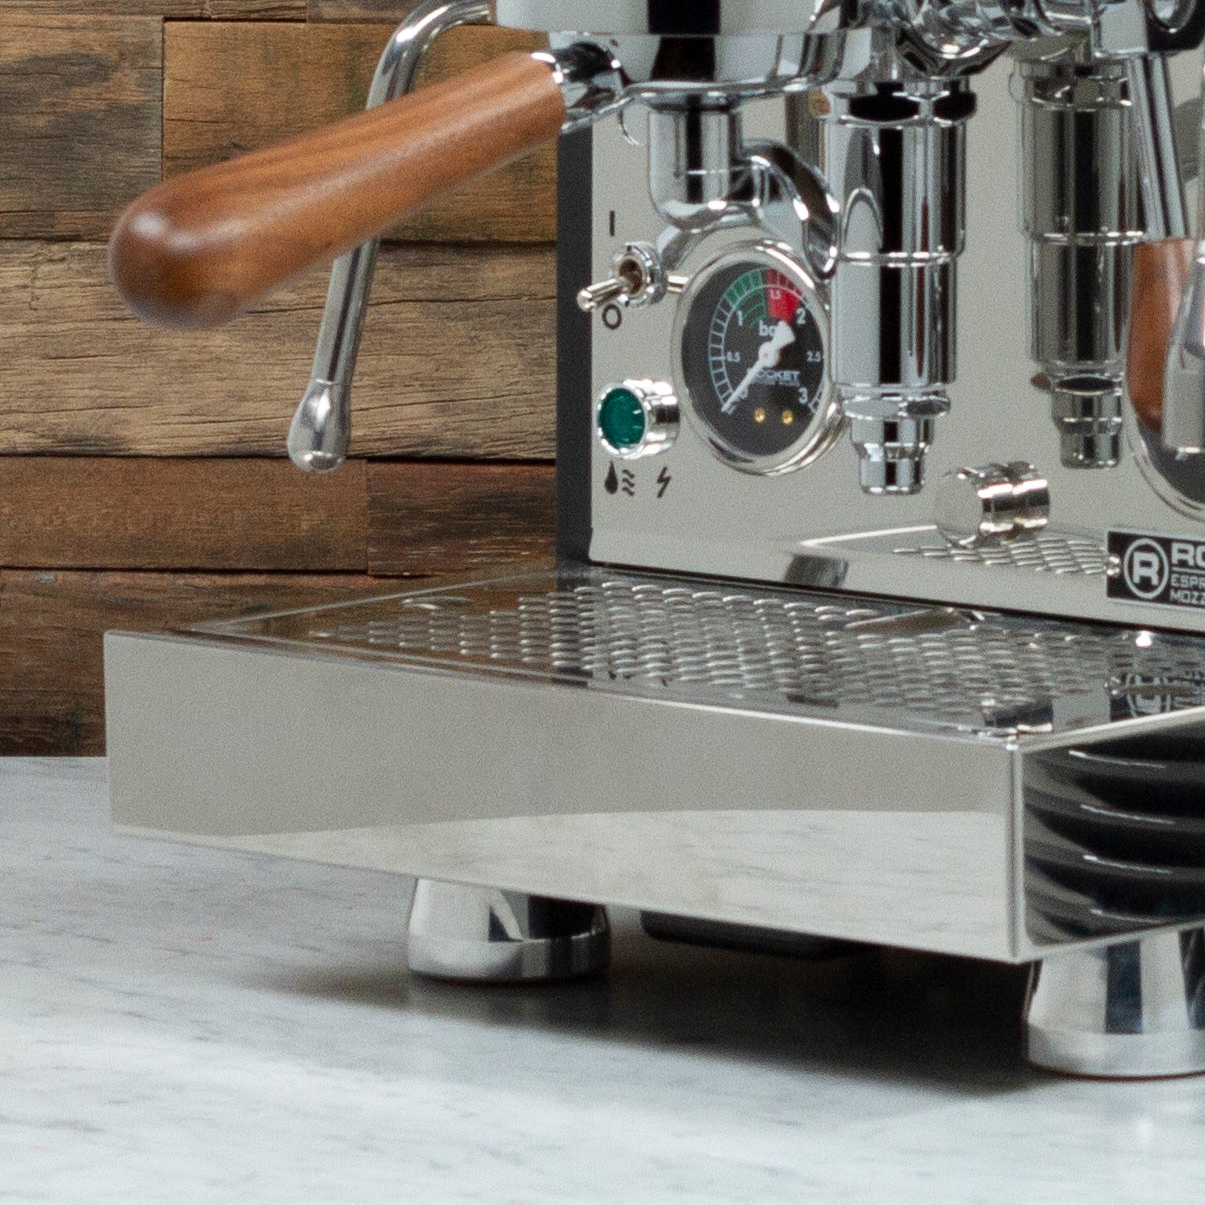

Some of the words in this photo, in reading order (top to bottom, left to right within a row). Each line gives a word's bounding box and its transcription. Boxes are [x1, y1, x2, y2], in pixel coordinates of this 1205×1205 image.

[796, 307, 806, 325] 2
[798, 387, 808, 405] 3
[1131, 551, 1160, 586] R
